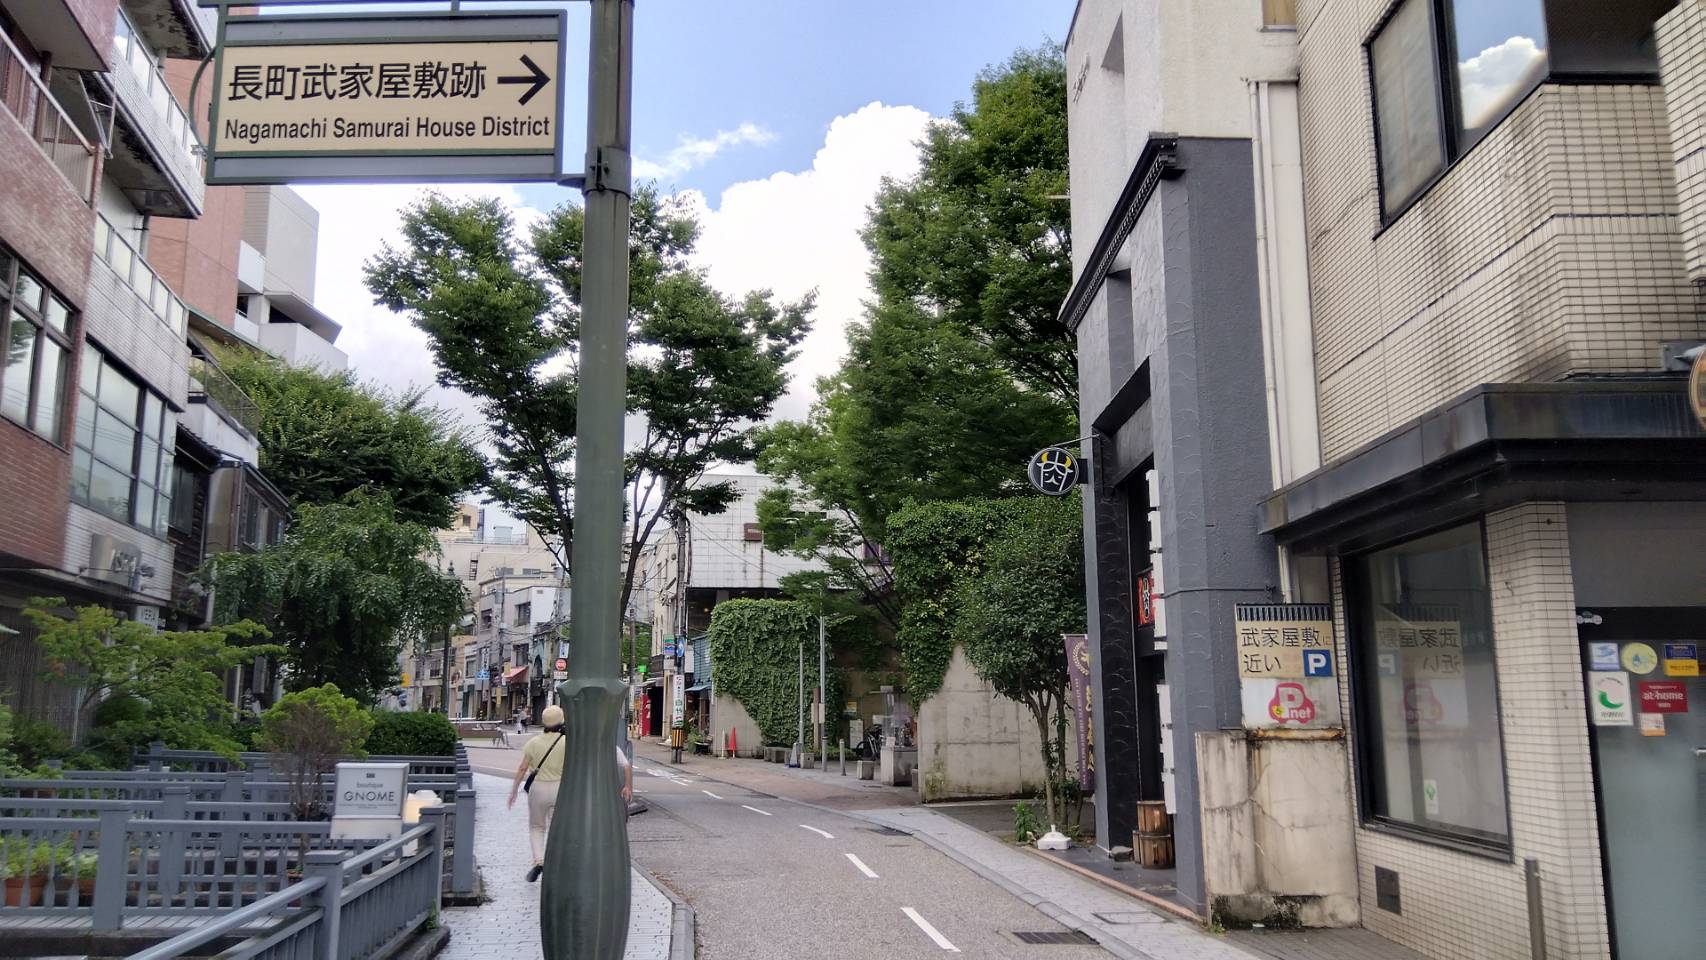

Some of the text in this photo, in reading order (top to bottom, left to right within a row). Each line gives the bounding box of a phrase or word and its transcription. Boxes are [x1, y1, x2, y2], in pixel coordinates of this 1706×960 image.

[228, 62, 487, 102] 長町武家屋敷跡
[225, 115, 550, 144] Nagamachi Samurai House District
[1243, 653, 1327, 674] 近い P
[343, 791, 395, 802] GNOME
